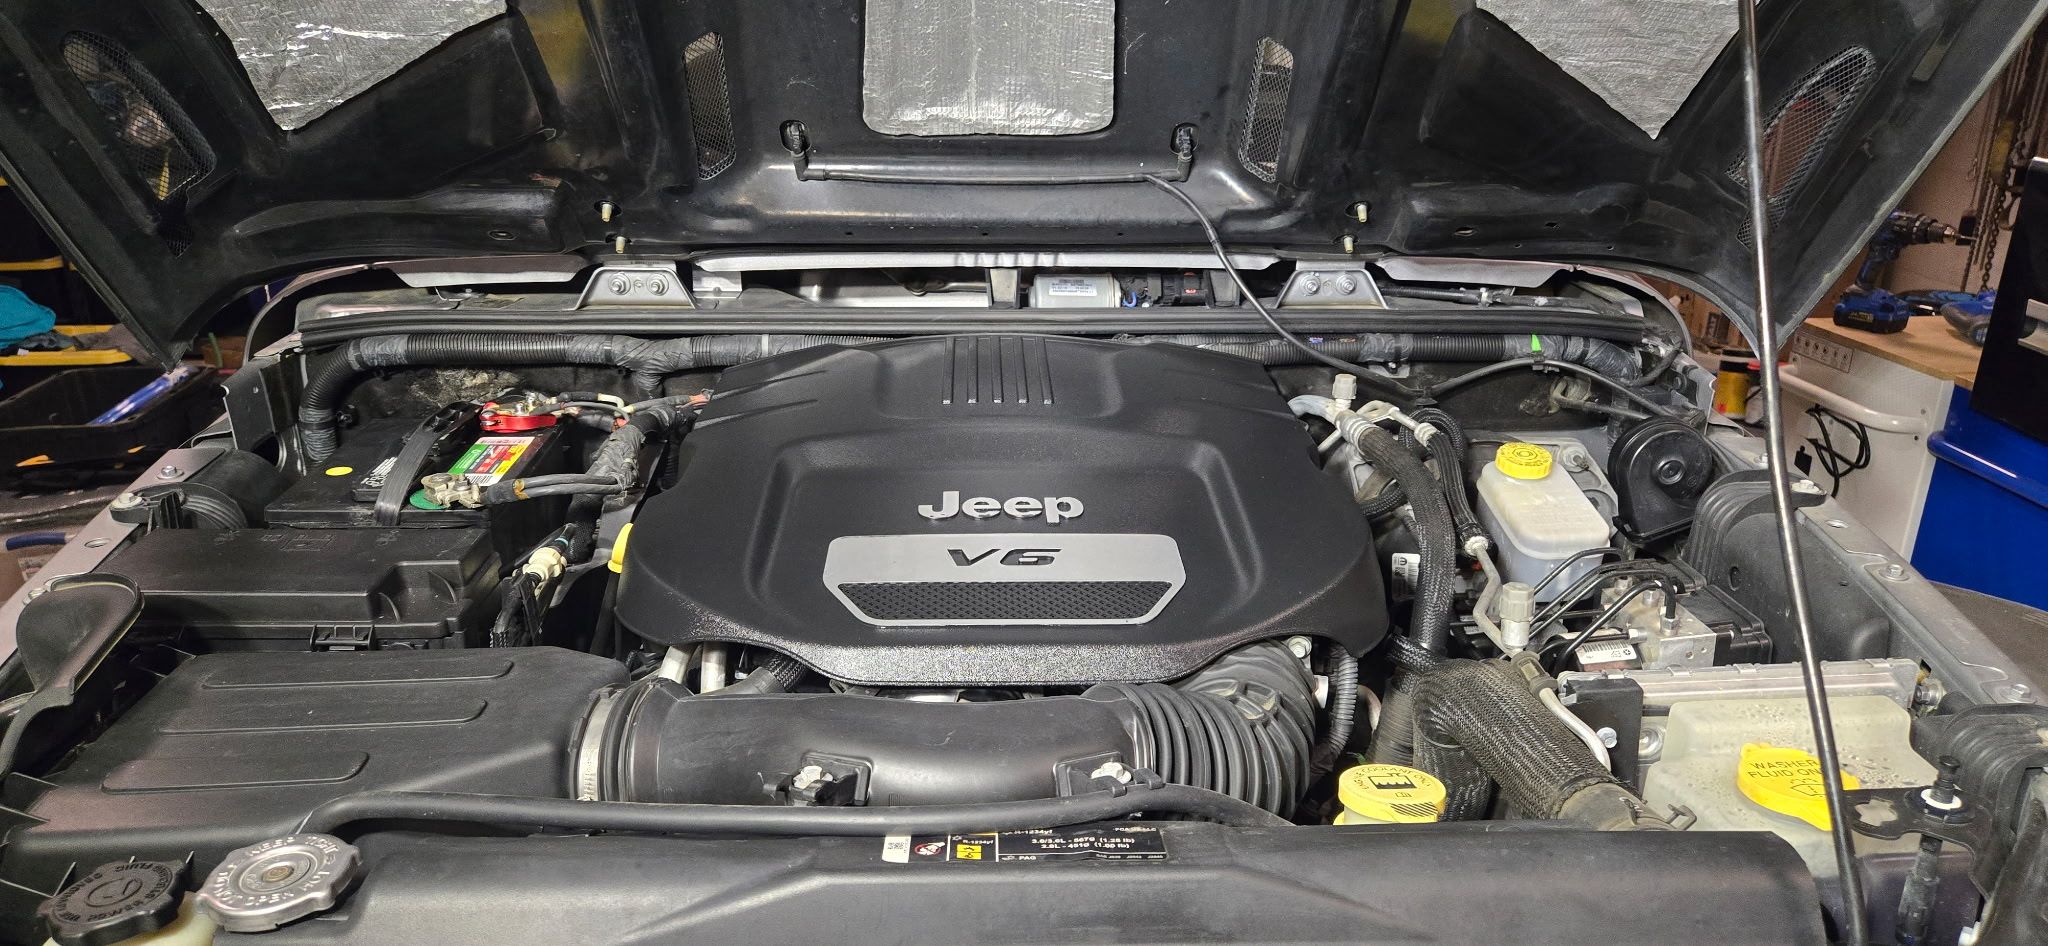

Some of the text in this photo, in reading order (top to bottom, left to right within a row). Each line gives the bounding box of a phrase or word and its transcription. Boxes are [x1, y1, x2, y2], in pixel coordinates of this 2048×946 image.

[918, 491, 1084, 525] Jeep
[947, 548, 1062, 566] V6
[1750, 760, 1818, 770] WASHER
[1748, 768, 1822, 779] FLUID ON
